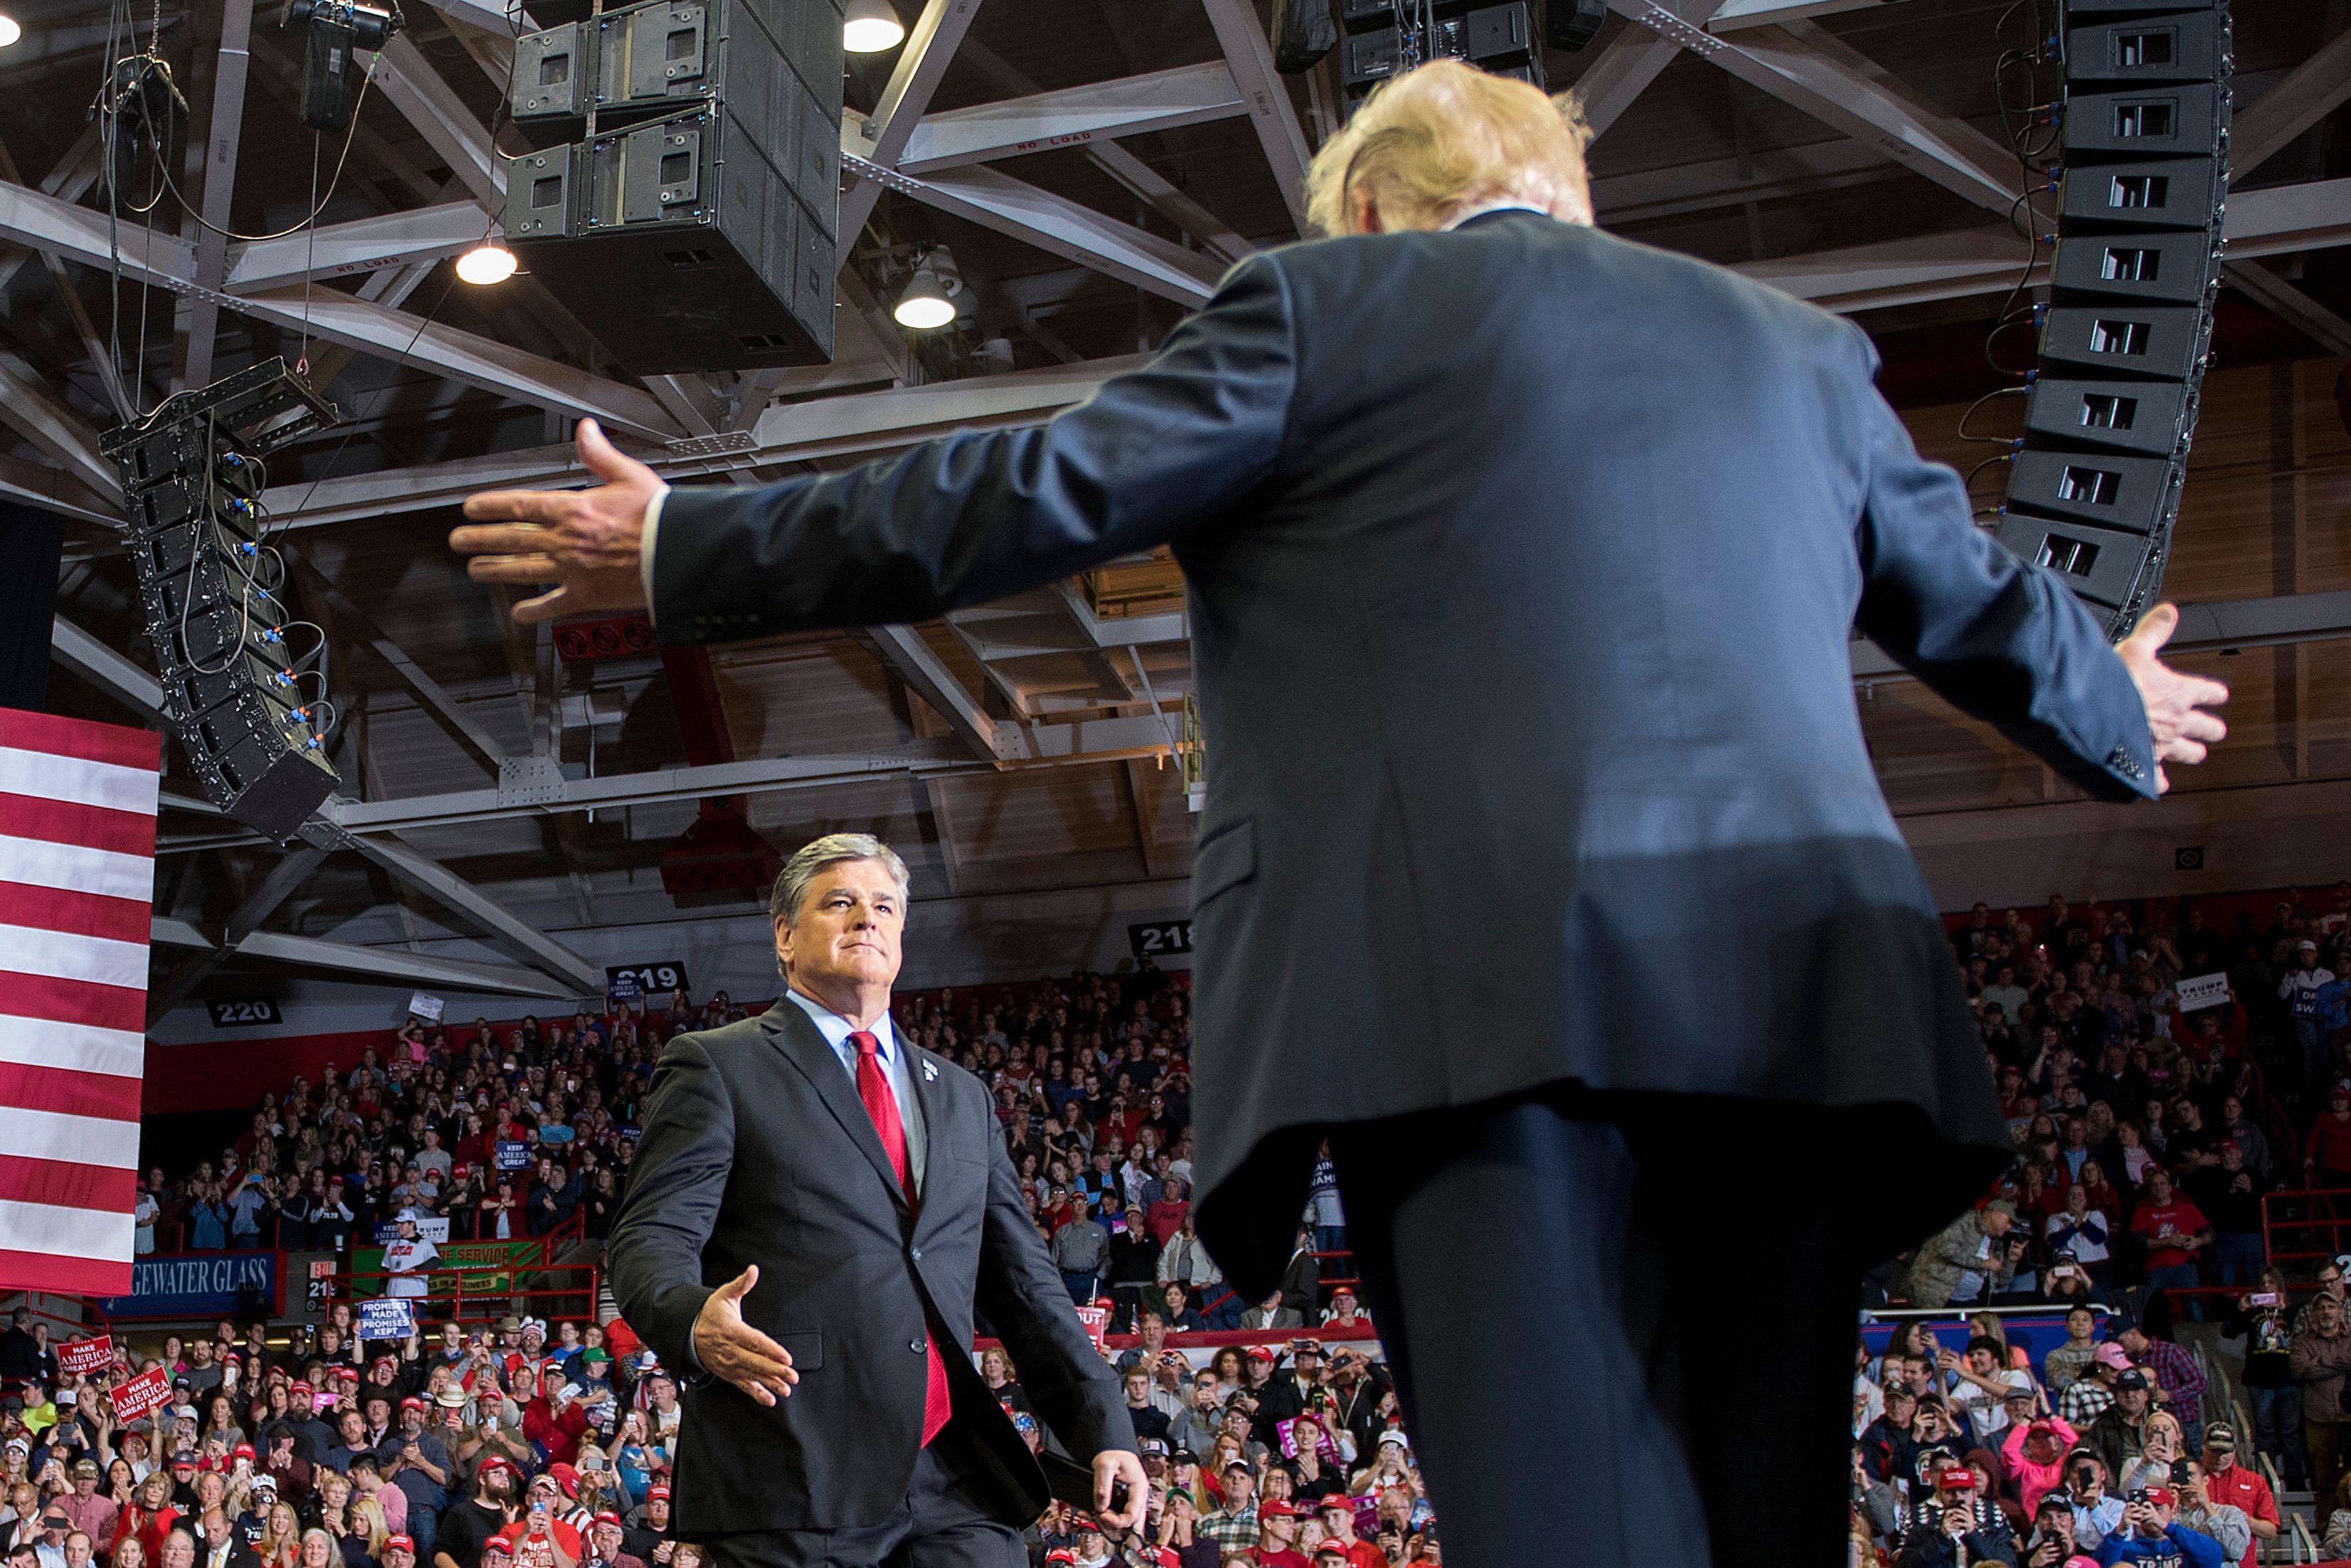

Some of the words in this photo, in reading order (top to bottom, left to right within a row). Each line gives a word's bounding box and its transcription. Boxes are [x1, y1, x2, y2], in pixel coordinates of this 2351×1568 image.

[1018, 142, 1036, 150] NO
[1050, 132, 1090, 145] LOAD
[363, 257, 398, 268] LOAD
[216, 1001, 271, 1022] 220
[1316, 1161, 1333, 1172] AIN
[458, 1246, 510, 1266] SERVICE
[131, 1262, 208, 1296] GEWATER
[213, 1258, 267, 1293] GLASS
[452, 1279, 492, 1288] BSINESS
[362, 1301, 407, 1312] PROMISES
[371, 1310, 398, 1318] MADE
[362, 1319, 410, 1329] PROMISES
[374, 1328, 398, 1336] KEPT
[61, 1347, 112, 1366] AMERICA
[73, 1345, 95, 1354] MAKE
[89, 1355, 112, 1369] AGAIN
[128, 1378, 151, 1394] MAKE
[117, 1379, 169, 1411] AMERICA
[120, 1402, 147, 1418] GREAT
[148, 1389, 171, 1407] AGAIN
